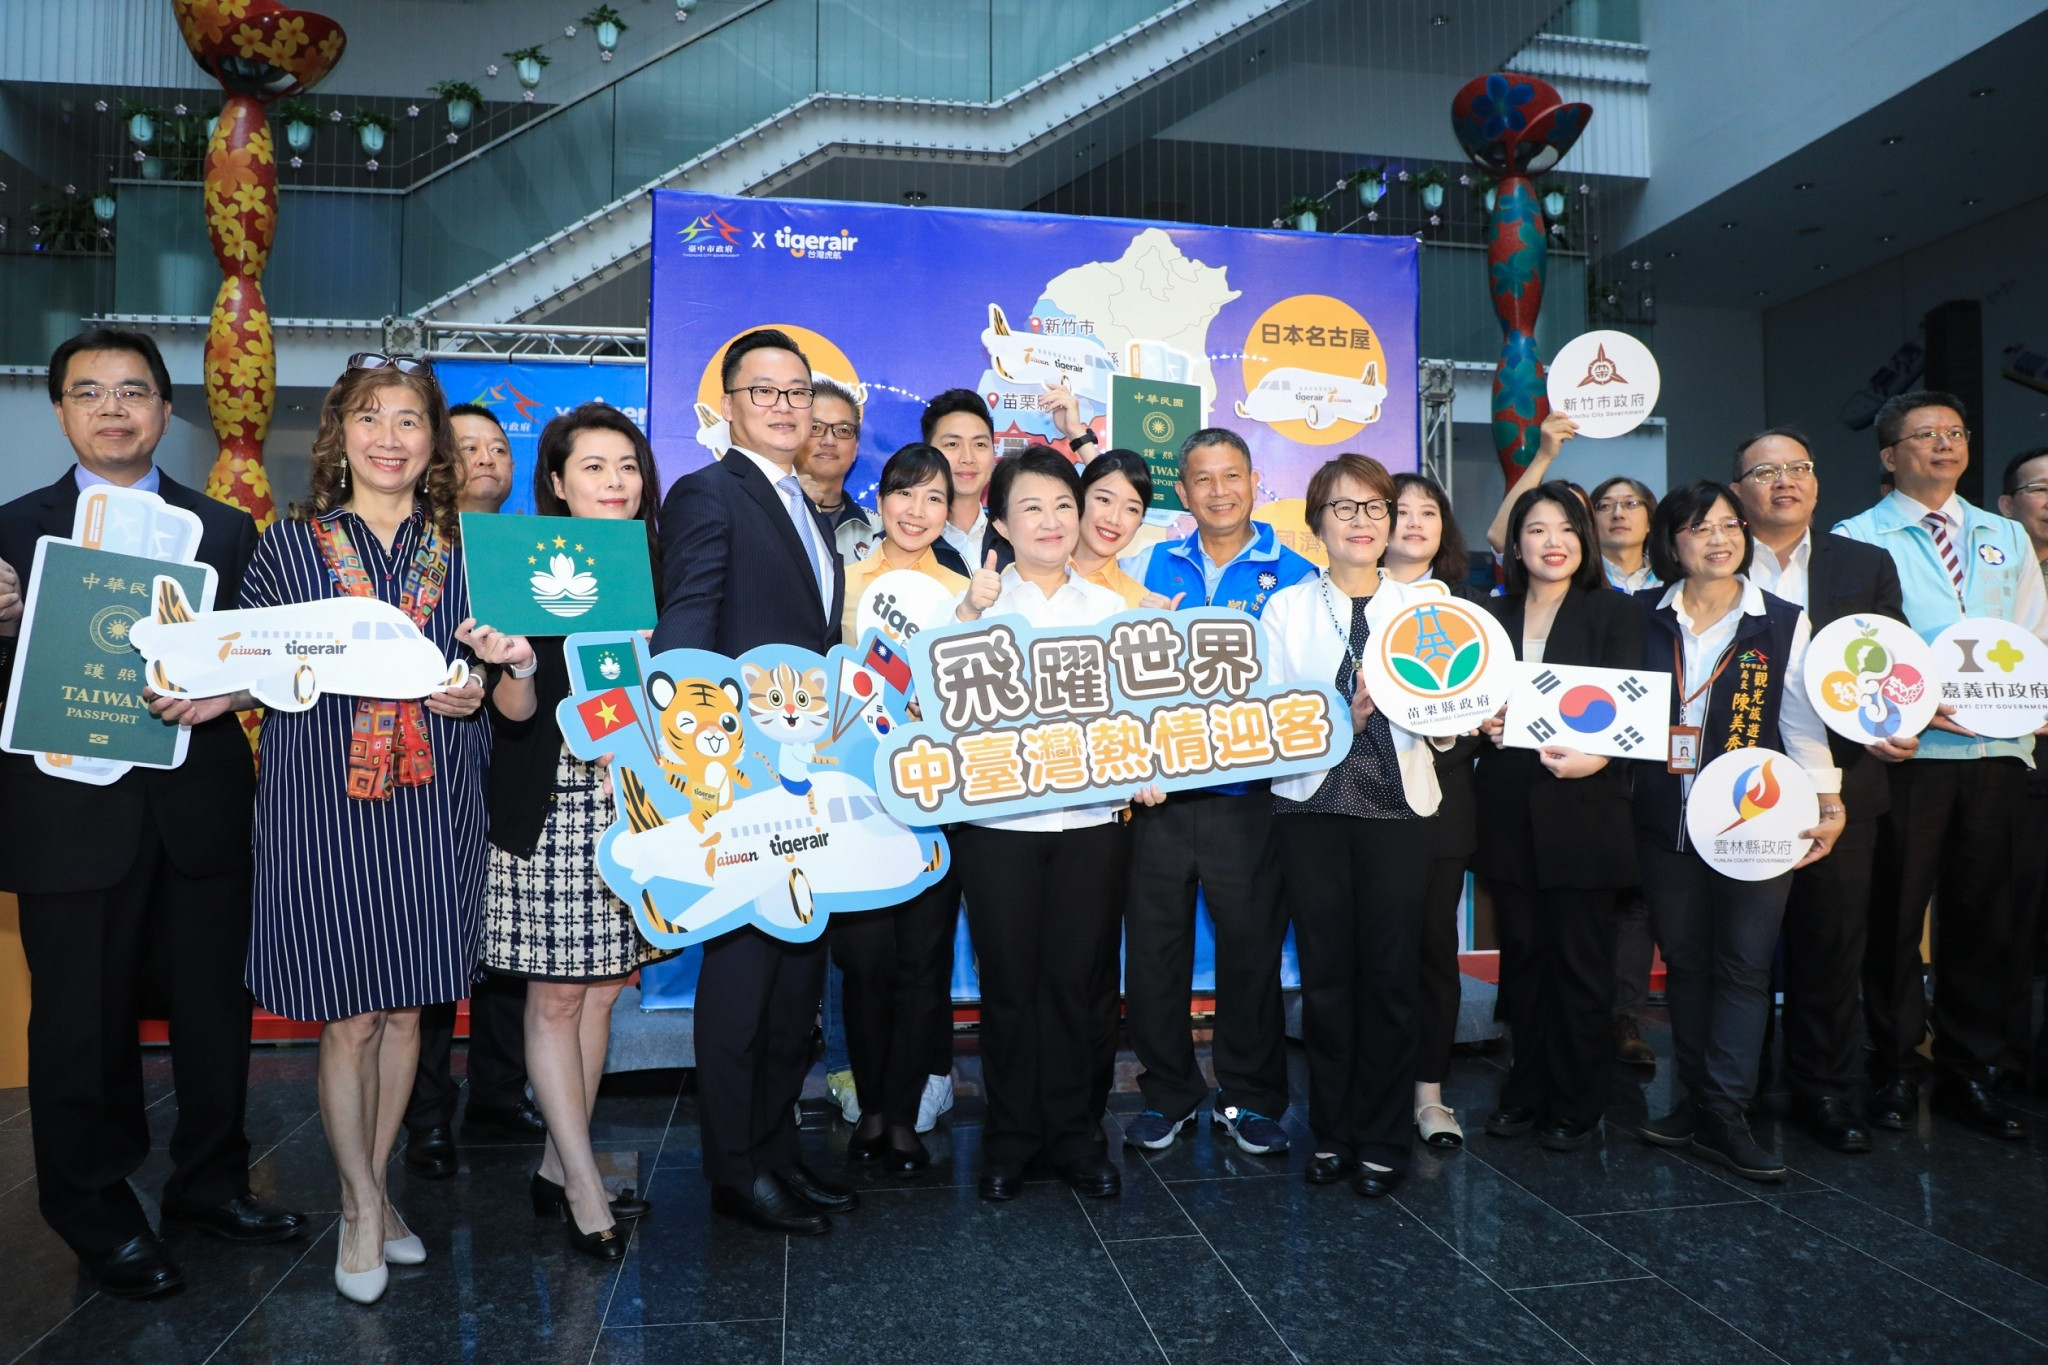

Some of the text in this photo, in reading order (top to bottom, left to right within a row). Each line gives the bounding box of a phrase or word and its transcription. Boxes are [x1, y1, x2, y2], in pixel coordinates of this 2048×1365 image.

[774, 225, 859, 258] tigerair
[1044, 318, 1095, 335] 新竹市
[1261, 323, 1371, 350] 日本名古屋
[1054, 359, 1084, 373] tigerair
[1133, 392, 1184, 408] 中華民國
[1295, 392, 1324, 404] tigerair
[1563, 393, 1645, 411] 新竹市政府
[1150, 465, 1180, 478] IWA
[82, 572, 149, 597] 中華民
[872, 592, 920, 640] tige
[285, 639, 347, 661] tigerair
[83, 663, 137, 682] 護照
[931, 618, 1261, 729] 飛躍世界
[1941, 681, 2048, 699] 嘉義市政府
[66, 707, 140, 725] PASSPORT
[1407, 694, 1490, 720] 苗栗縣政府
[892, 690, 1330, 809] 中臺灣熱情迎客
[699, 826, 830, 881] Taiwan tigerair
[1713, 839, 1792, 856] 雲林縣政府
